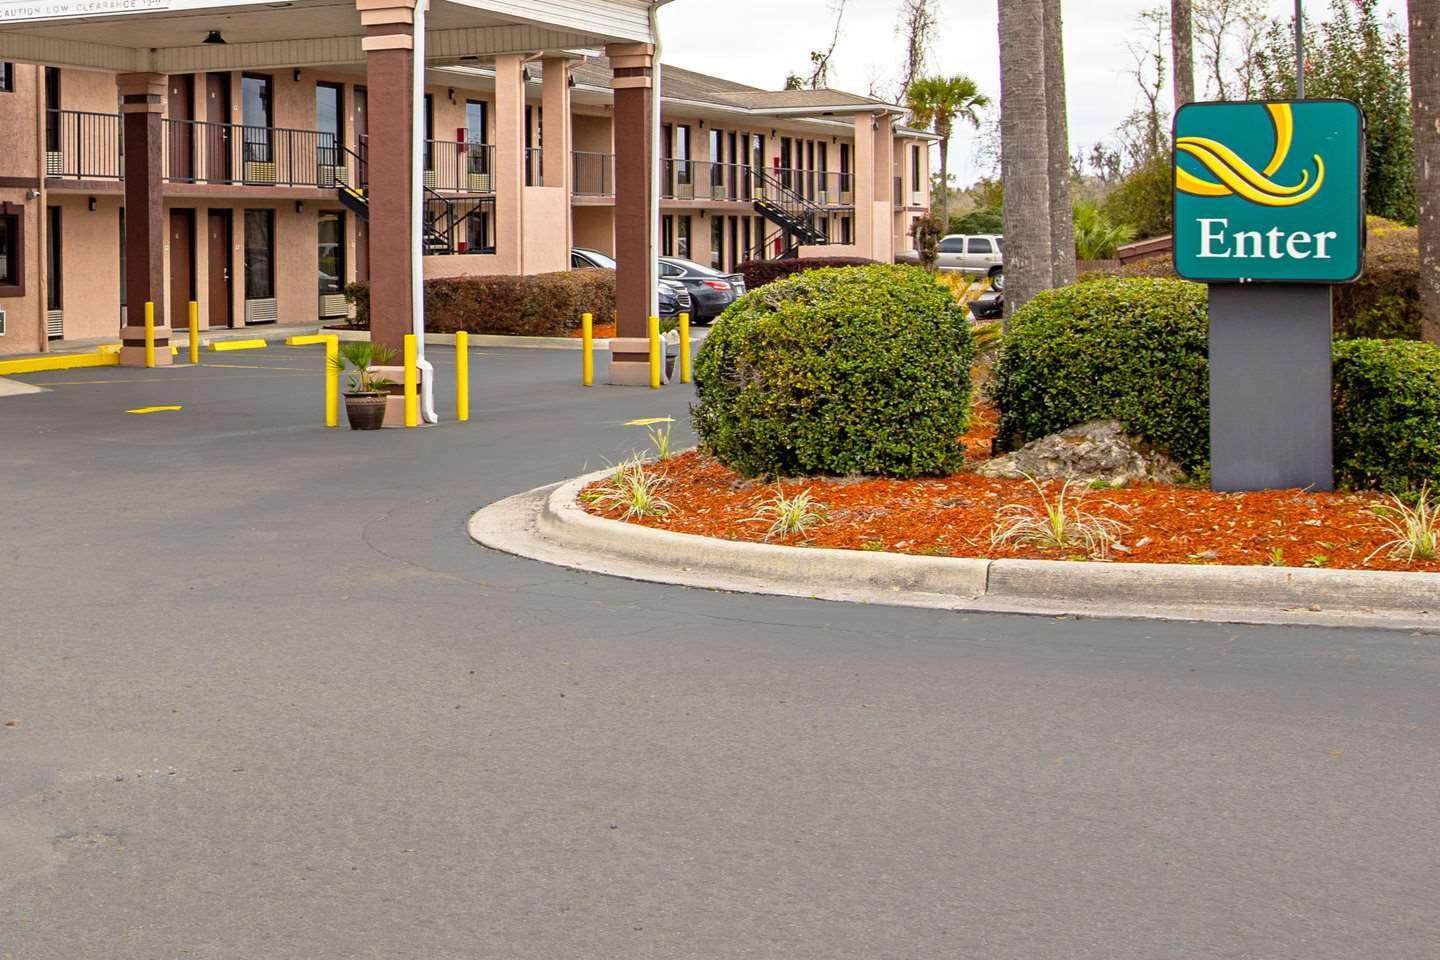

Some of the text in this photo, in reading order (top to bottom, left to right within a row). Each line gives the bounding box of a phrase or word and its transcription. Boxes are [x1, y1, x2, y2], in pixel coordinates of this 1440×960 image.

[46, 5, 69, 14] LOW
[76, 0, 136, 12] CLEARANCE
[1196, 218, 1337, 259] Enter
